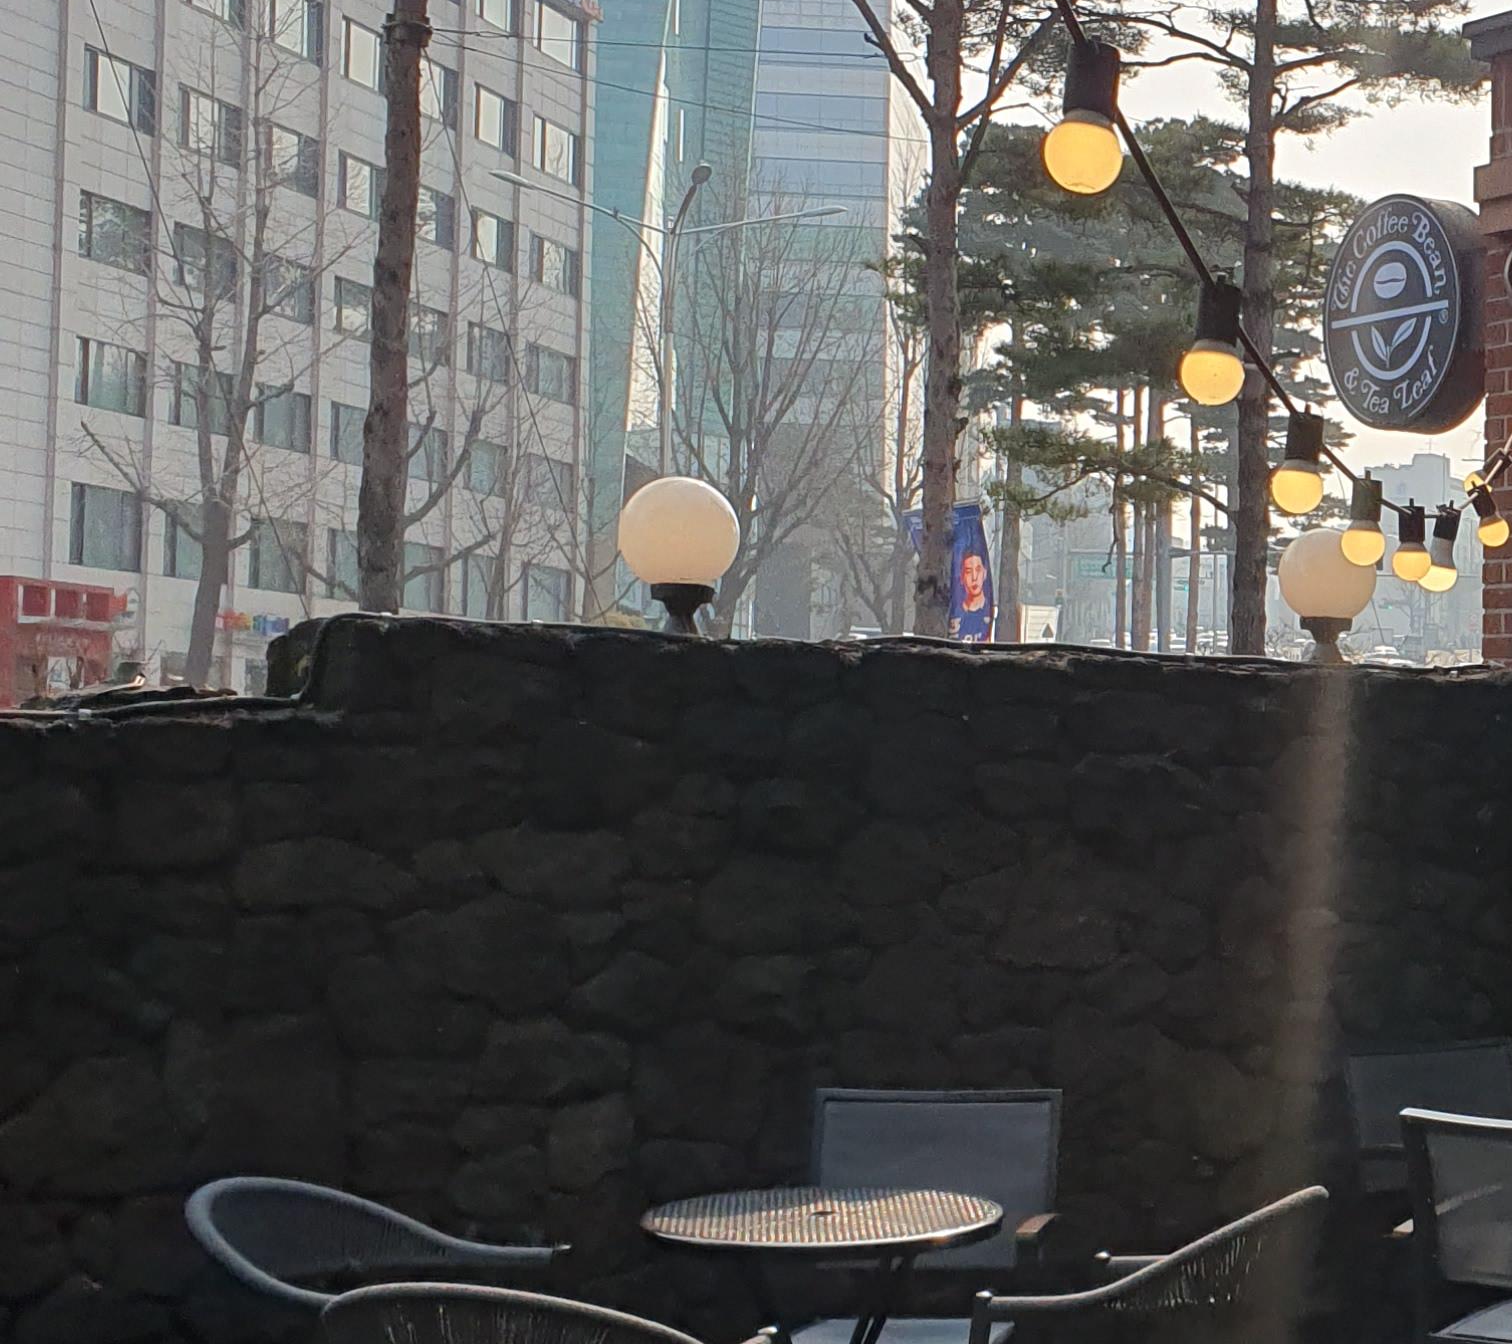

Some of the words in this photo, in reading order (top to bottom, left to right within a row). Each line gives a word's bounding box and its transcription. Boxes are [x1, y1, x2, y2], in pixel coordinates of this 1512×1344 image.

[1331, 263, 1357, 311] The
[1353, 207, 1409, 259] Coffee
[1411, 211, 1448, 295] Bean
[1343, 367, 1360, 395] &
[1361, 380, 1390, 415] Tea
[1393, 344, 1441, 411] Leaf
